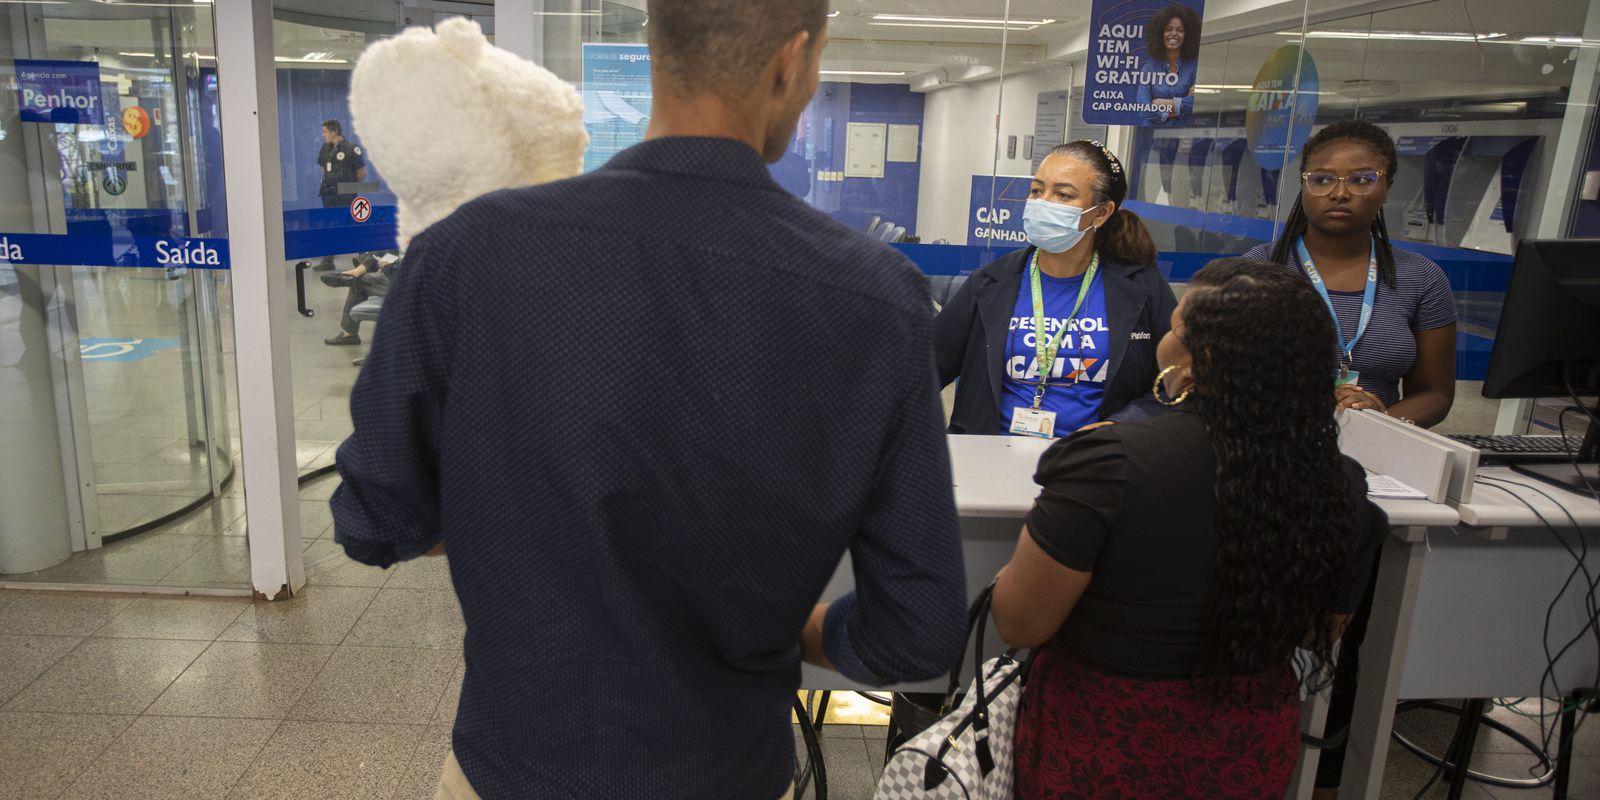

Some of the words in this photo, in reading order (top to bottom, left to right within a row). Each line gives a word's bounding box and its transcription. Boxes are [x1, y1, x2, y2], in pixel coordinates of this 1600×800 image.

[1098, 24, 1144, 38] AQUI
[1097, 39, 1130, 54] TEM
[590, 52, 609, 60] PORTA
[1096, 55, 1140, 69] WI-FI
[1095, 70, 1179, 86] GRATUITO
[23, 89, 98, 108] Penhor
[1093, 90, 1124, 100] CAIXA
[1092, 102, 1112, 111] CAP
[1114, 103, 1173, 113] GANHADOR
[976, 207, 1010, 224] CAP
[155, 240, 220, 265] Saída
